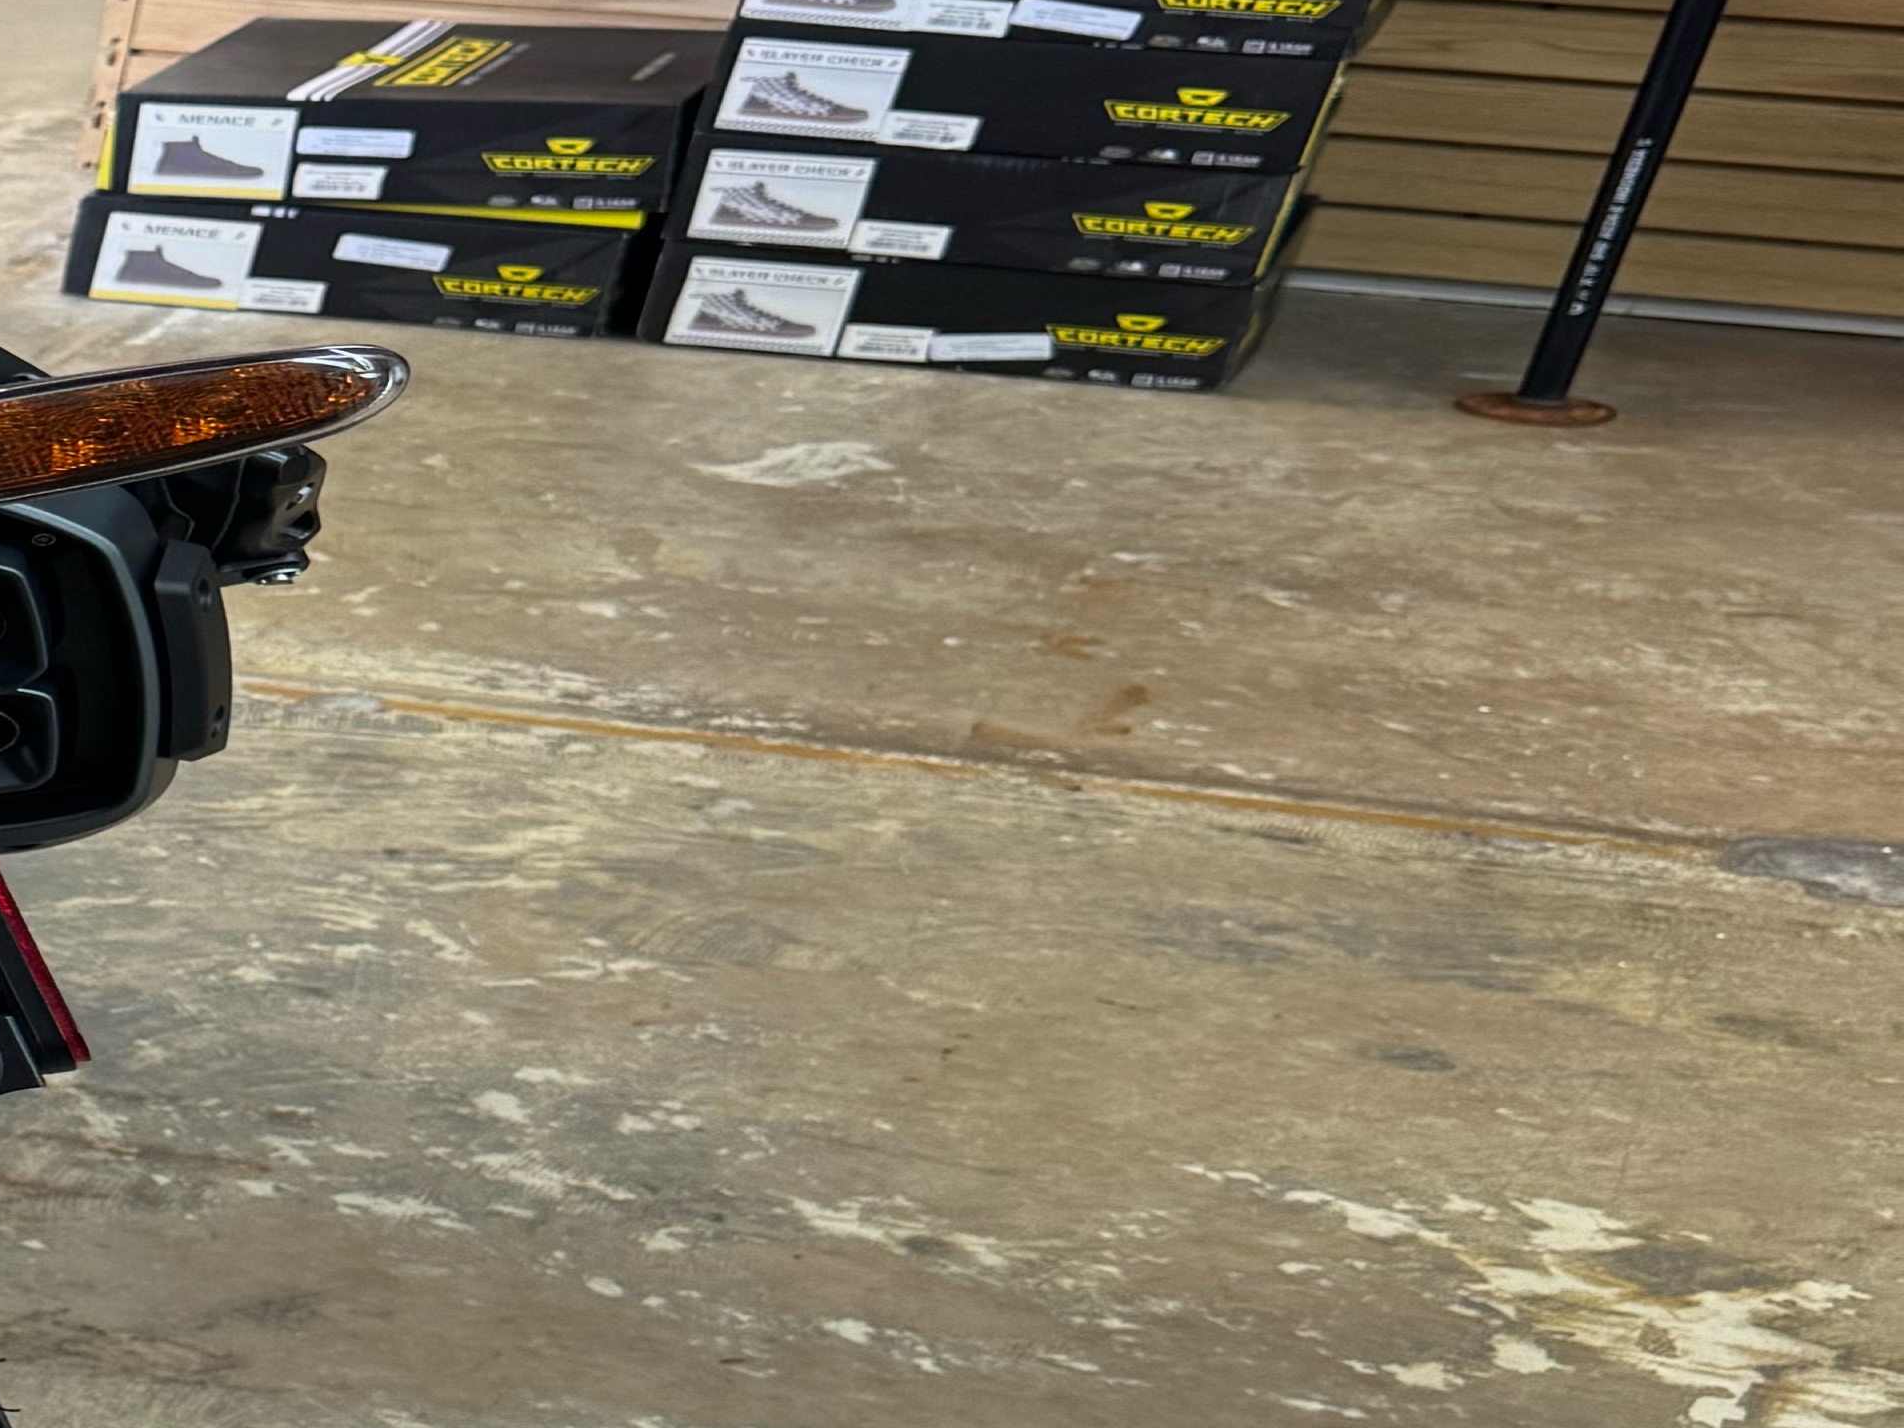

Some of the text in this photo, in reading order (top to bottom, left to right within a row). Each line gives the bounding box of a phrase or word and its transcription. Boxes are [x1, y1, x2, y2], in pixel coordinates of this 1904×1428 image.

[177, 113, 256, 127] MENACE
[1113, 105, 1275, 129] CORTECH
[492, 156, 643, 173] CORTECH
[143, 224, 222, 239] MENACE
[1081, 218, 1243, 241] CORTECH
[442, 280, 587, 302] CORTECH
[1055, 327, 1213, 354] CORTECH
